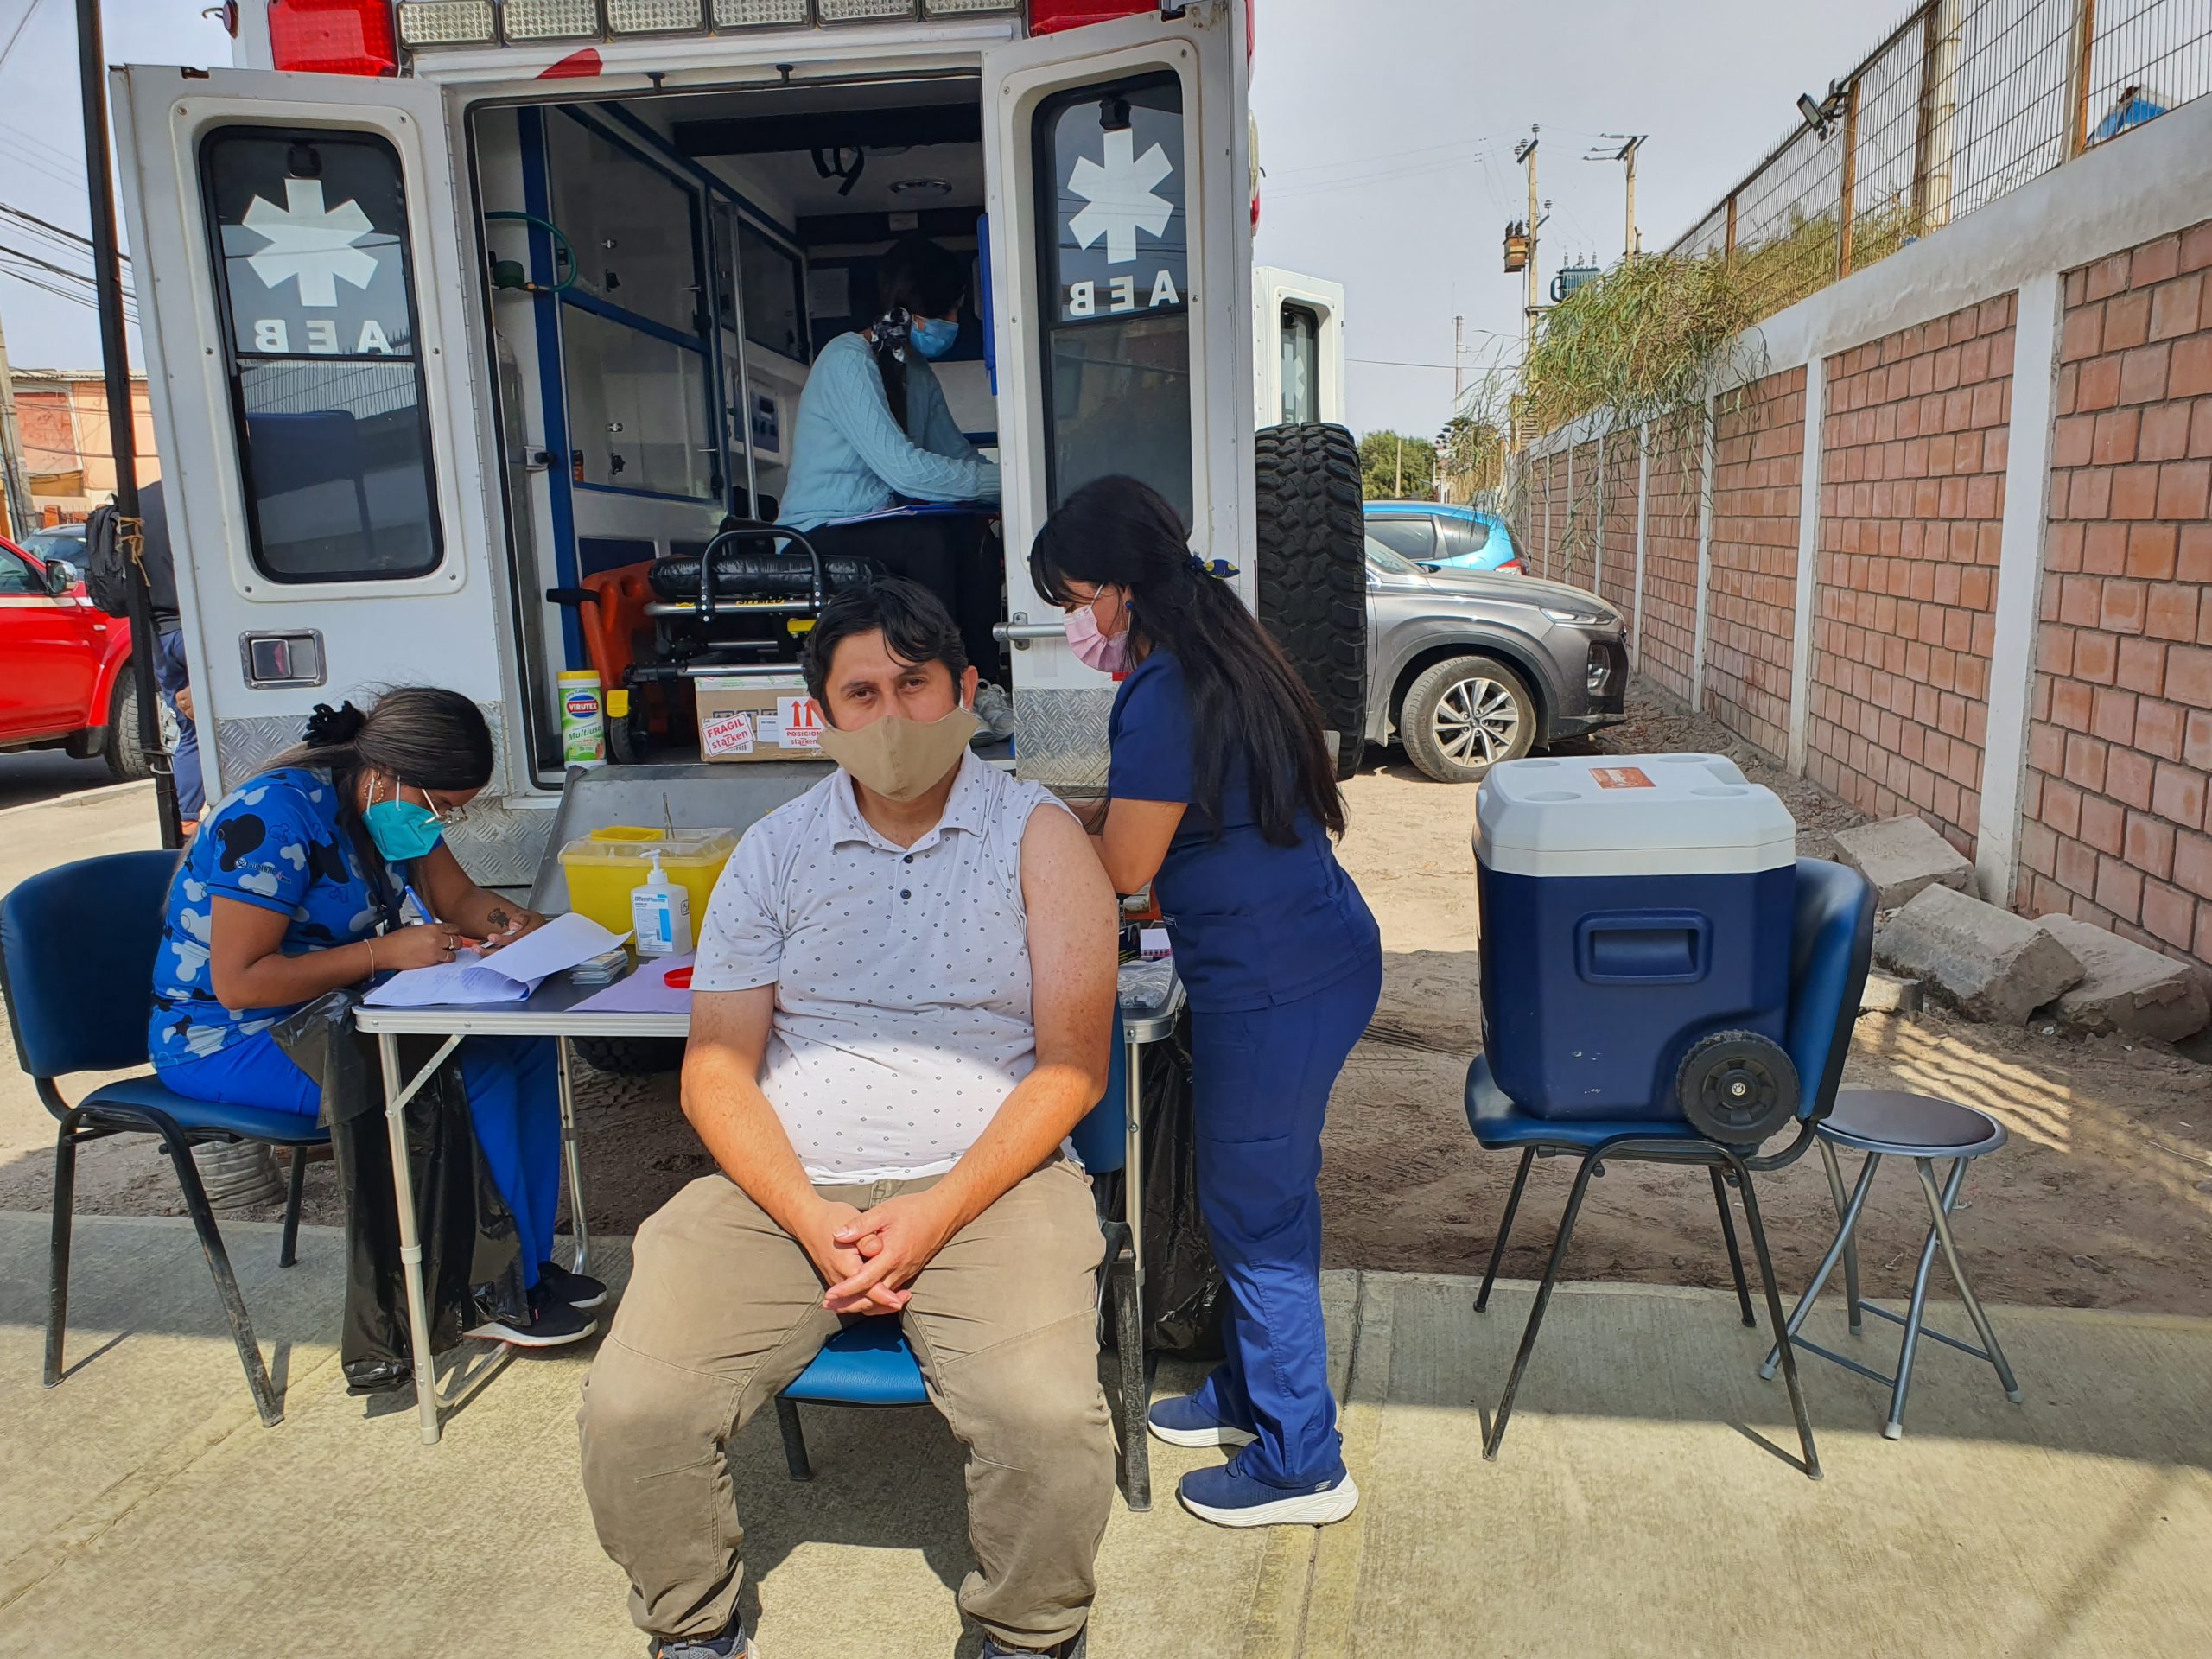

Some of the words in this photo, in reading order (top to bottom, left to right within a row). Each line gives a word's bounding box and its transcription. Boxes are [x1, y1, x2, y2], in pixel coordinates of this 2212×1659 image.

[569, 702, 597, 711] VIRUTEX
[568, 726, 601, 741] Multiuso
[707, 718, 745, 739] FRAGIL
[711, 730, 748, 749] starken
